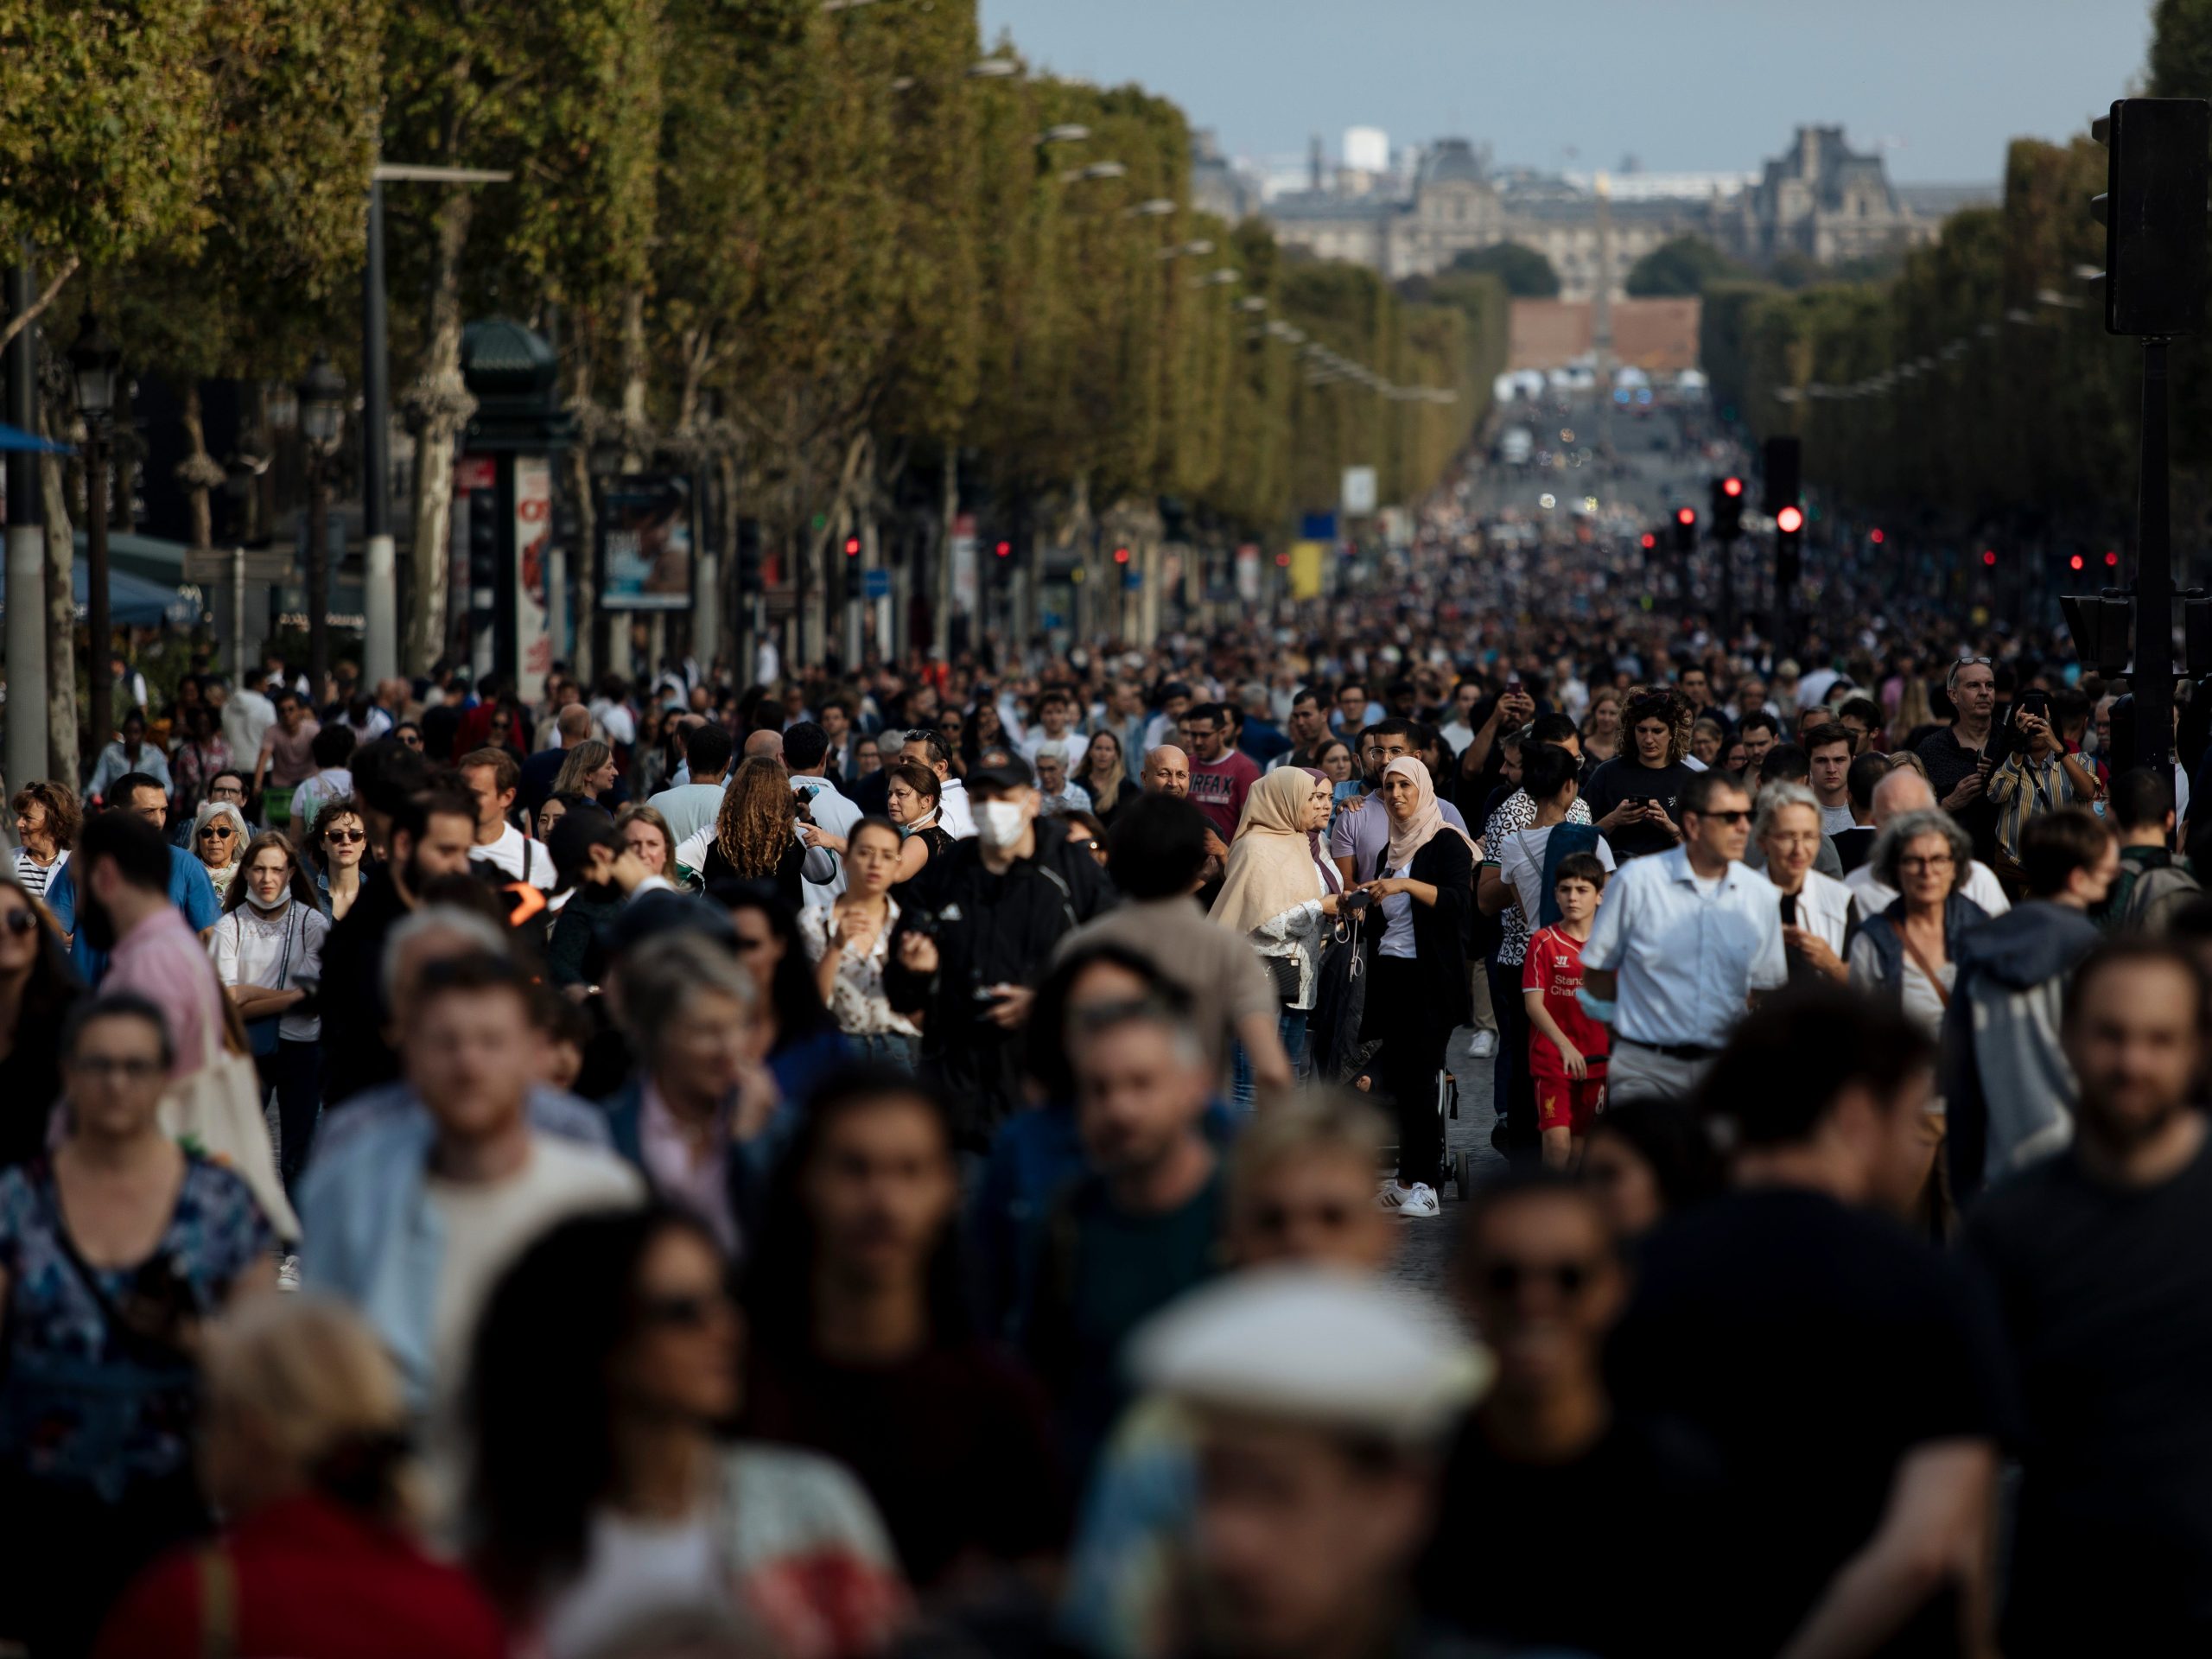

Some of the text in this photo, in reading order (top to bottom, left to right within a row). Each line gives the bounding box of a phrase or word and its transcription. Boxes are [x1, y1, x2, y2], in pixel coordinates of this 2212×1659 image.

[1189, 773, 1235, 796] IRFAX
[1551, 986, 1577, 997] Char
[1595, 1084, 1605, 1115] 8
